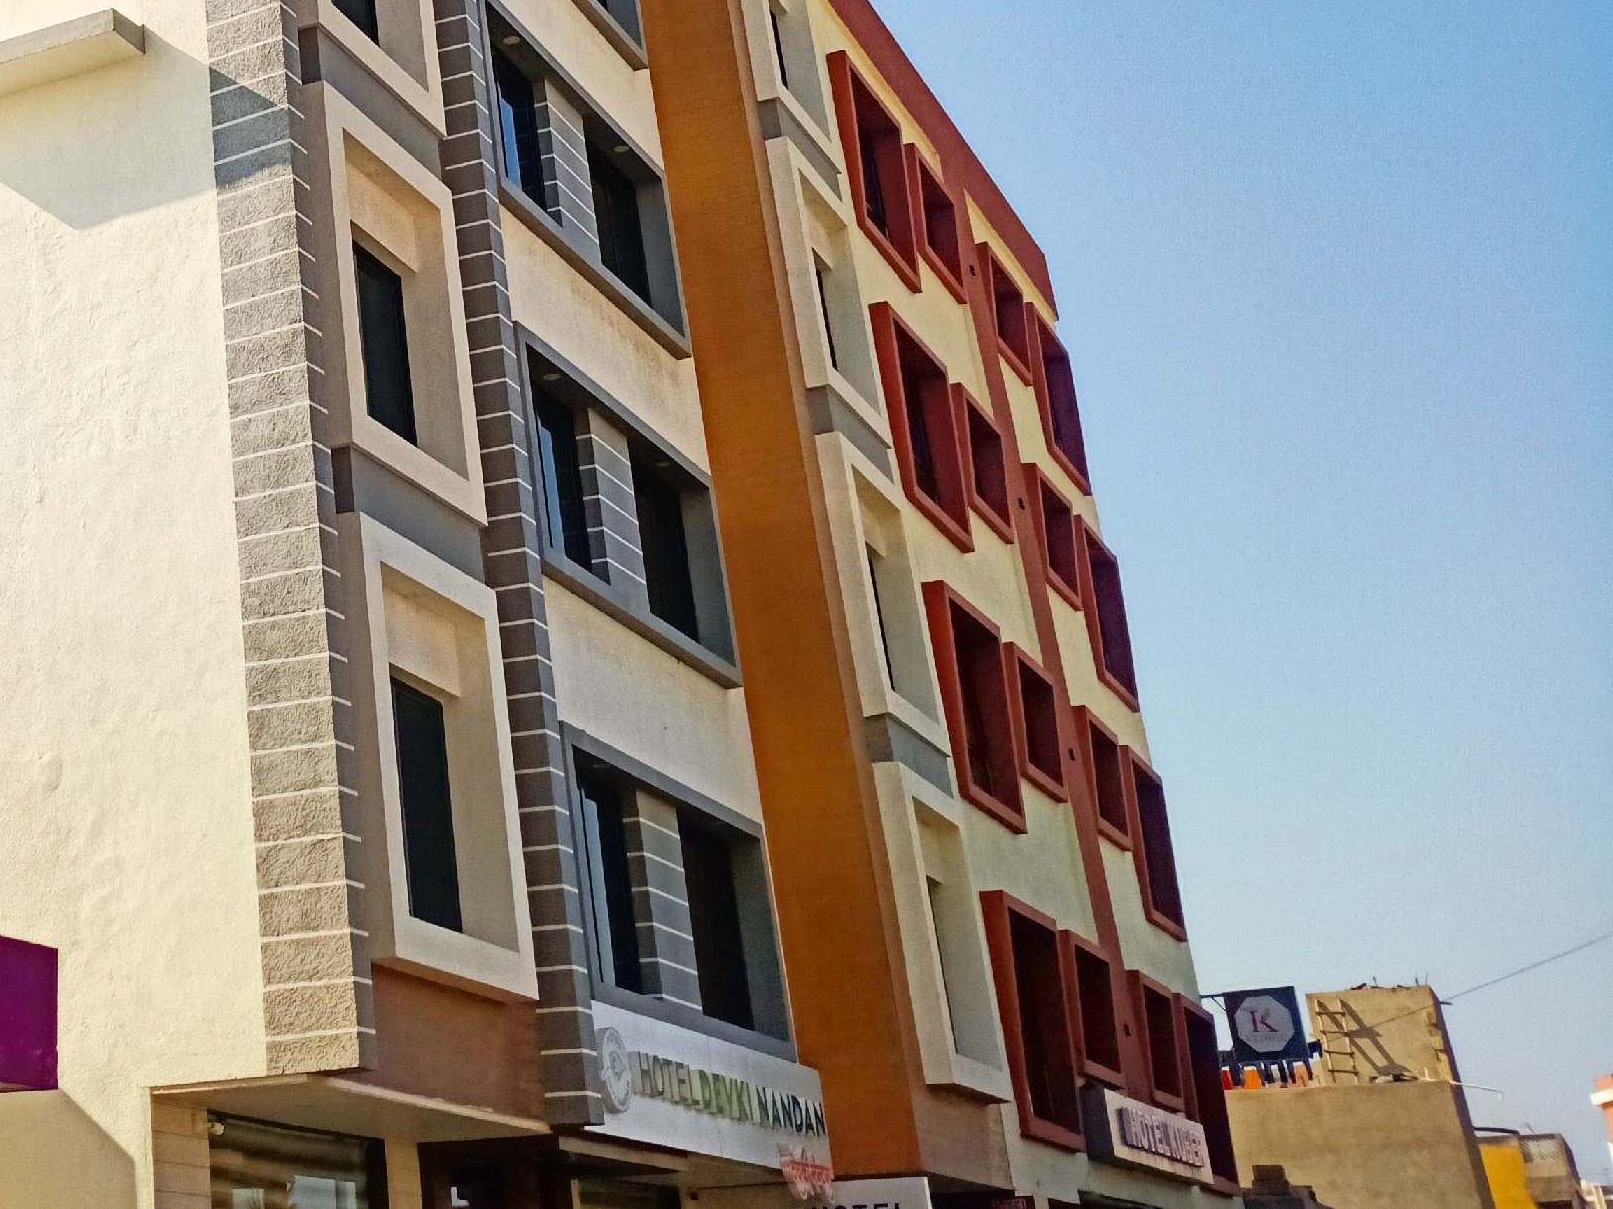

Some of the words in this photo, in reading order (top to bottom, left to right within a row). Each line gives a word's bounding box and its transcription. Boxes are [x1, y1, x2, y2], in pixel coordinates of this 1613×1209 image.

[636, 1050, 701, 1107] HOTEL
[755, 1084, 826, 1137] NANDAN
[1125, 1107, 1171, 1159] HOTEL
